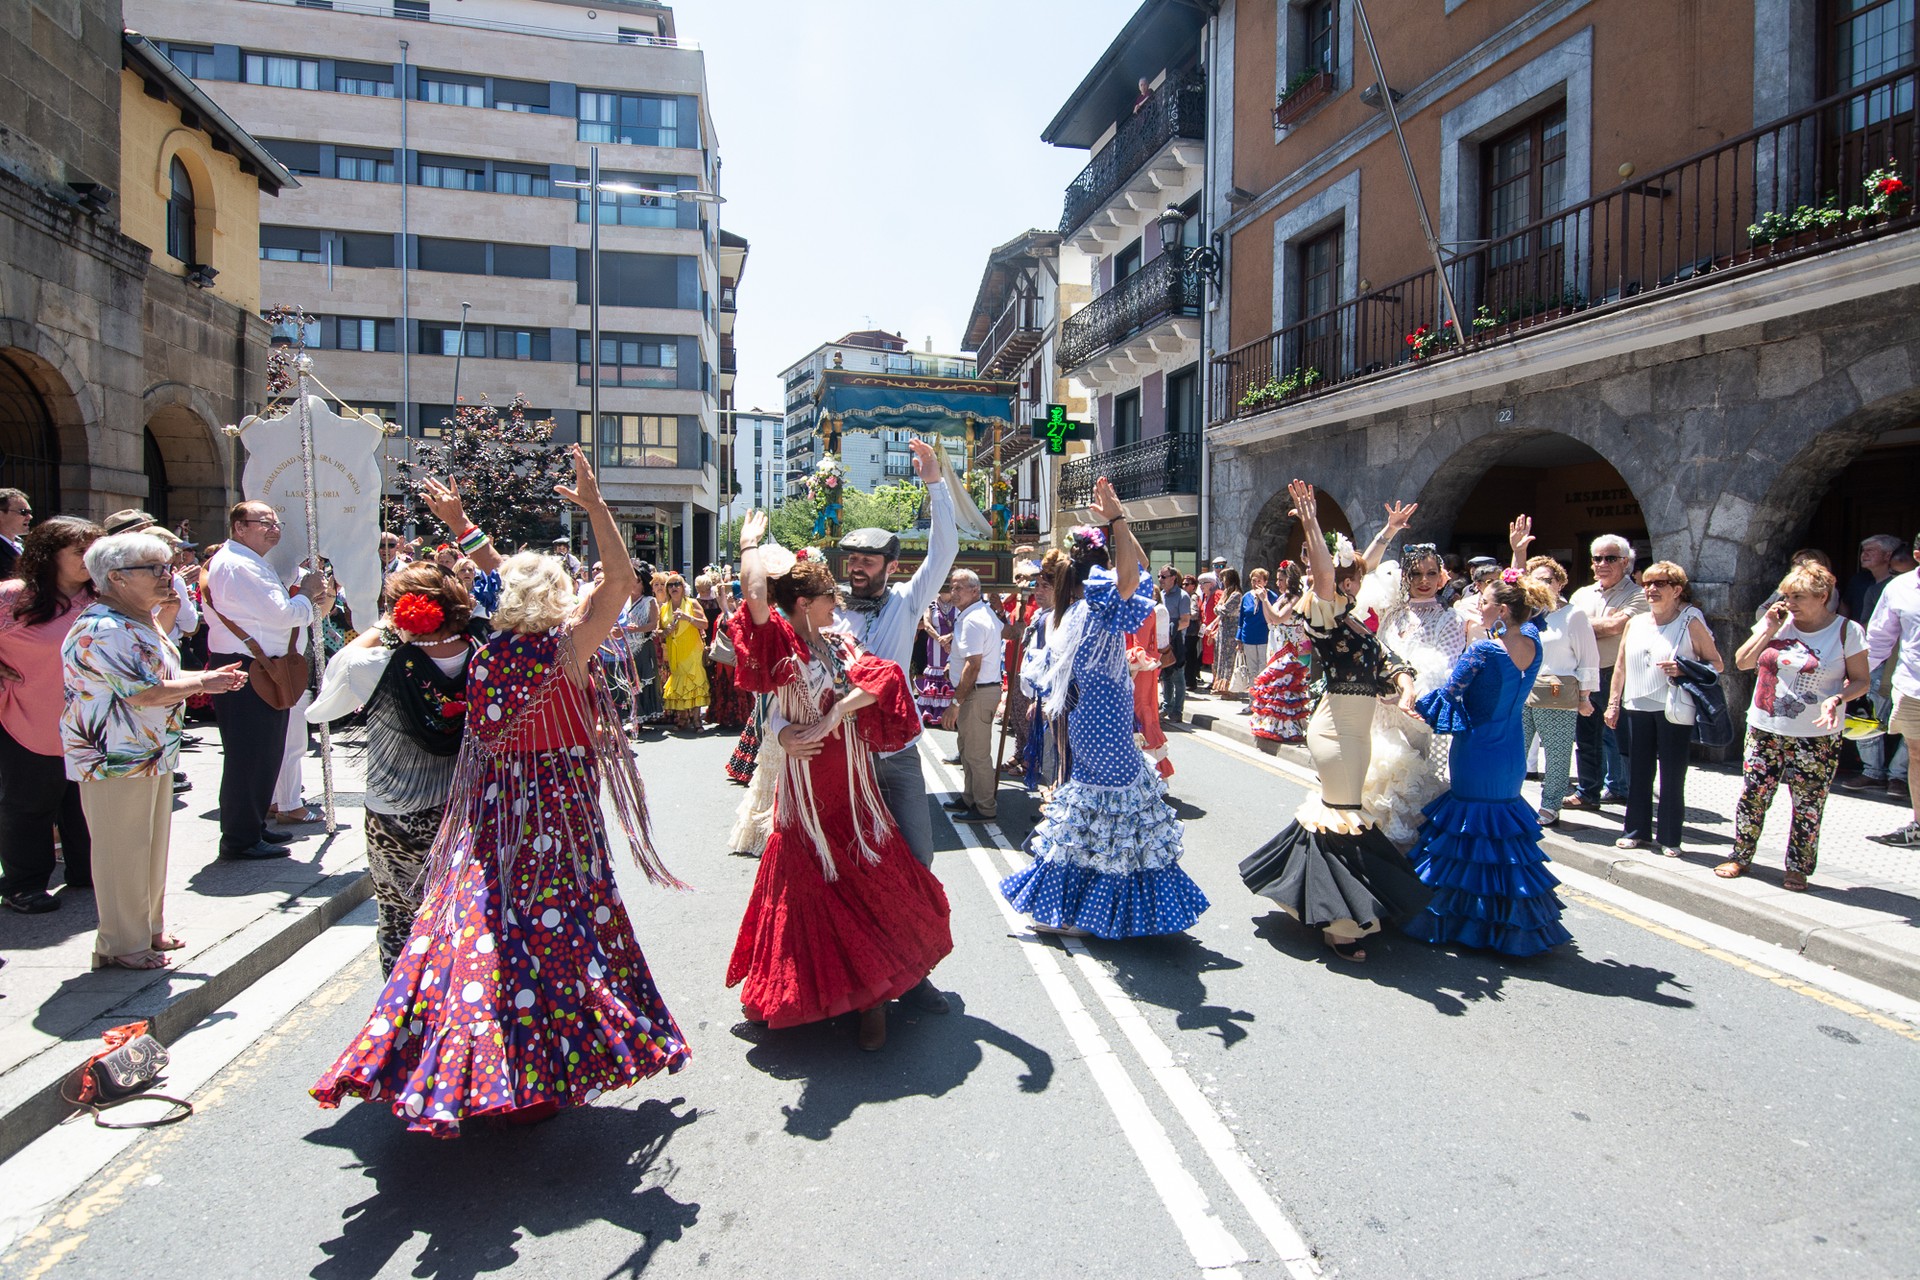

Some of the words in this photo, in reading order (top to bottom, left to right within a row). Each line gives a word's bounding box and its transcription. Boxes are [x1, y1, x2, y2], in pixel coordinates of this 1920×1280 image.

[1498, 410, 1511, 422] 22
[262, 456, 296, 496] HERMANDAD
[334, 460, 346, 473] DEL
[285, 490, 340, 498] LASAE-ORIA
